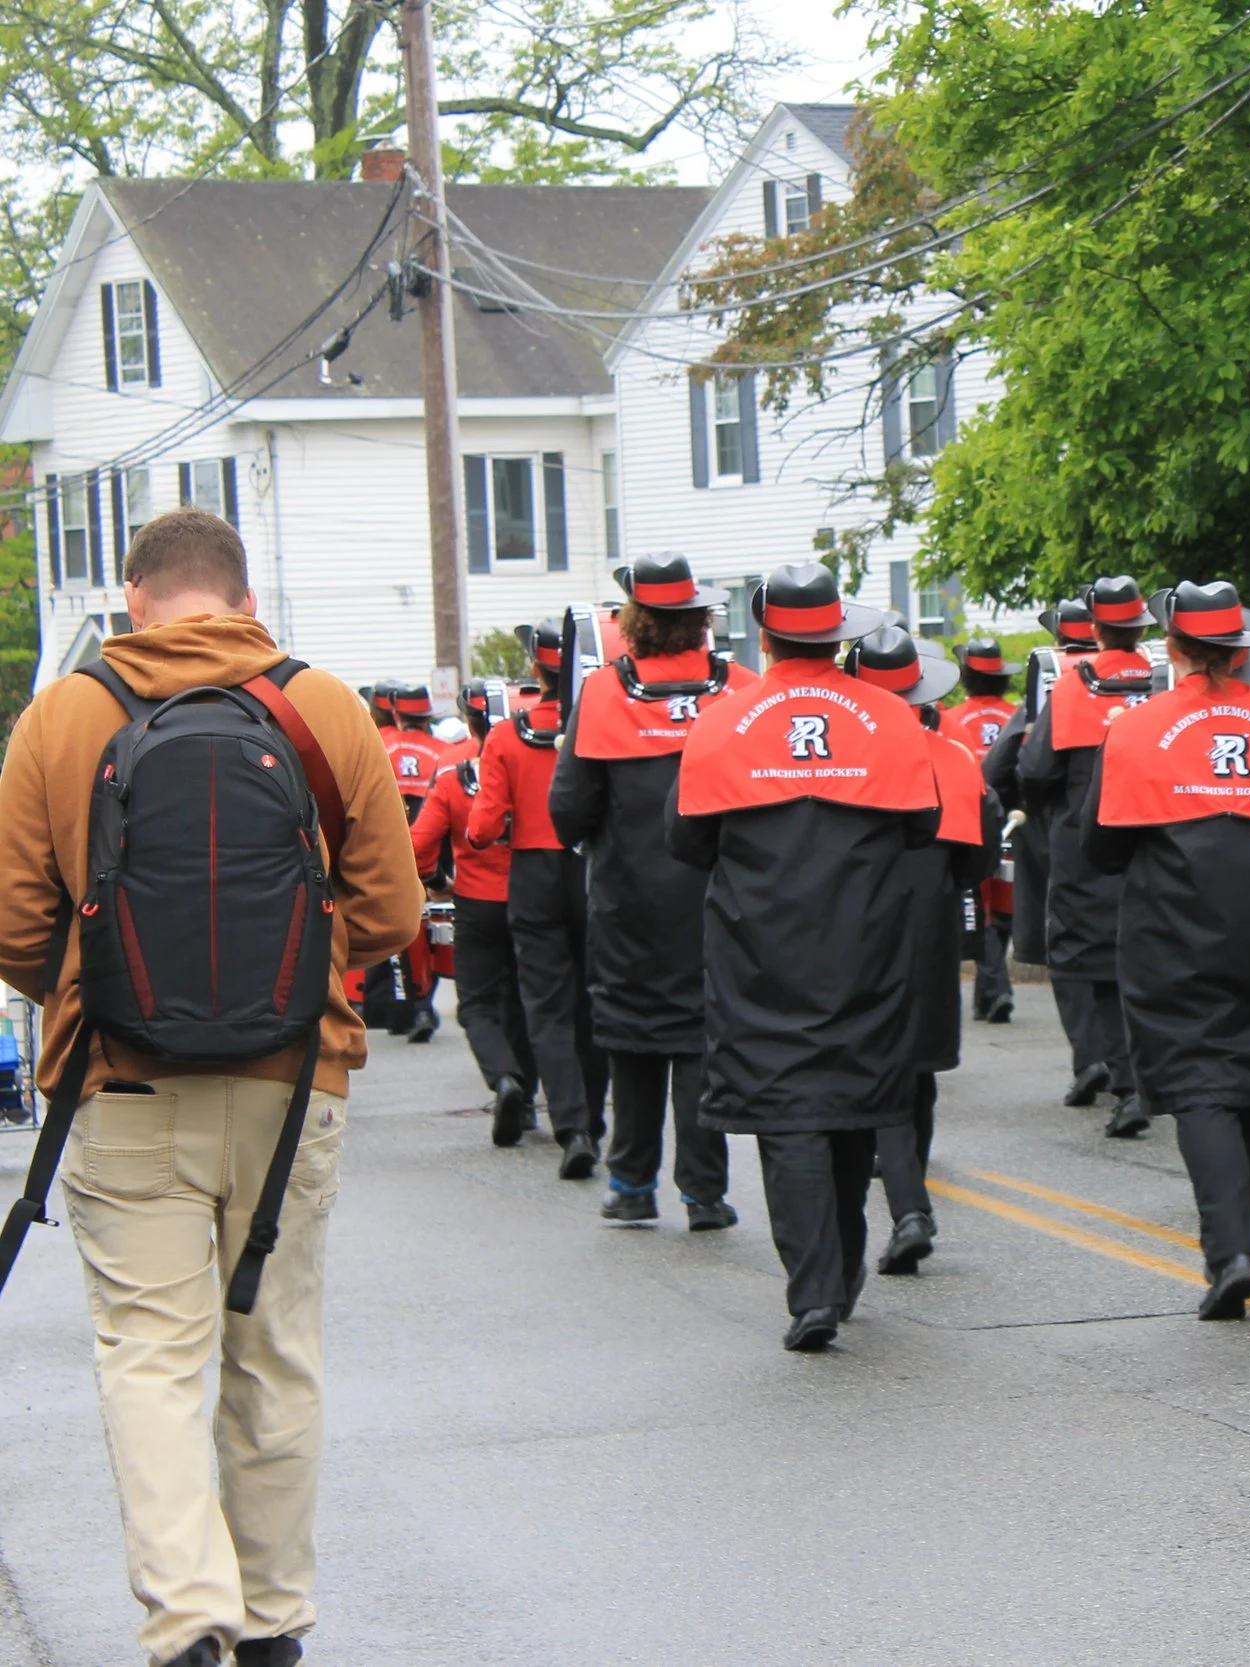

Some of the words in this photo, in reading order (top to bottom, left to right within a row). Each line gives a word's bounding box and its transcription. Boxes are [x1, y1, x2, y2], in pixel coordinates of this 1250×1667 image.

[736, 692, 786, 735] READING
[788, 687, 858, 713] MEMORIAL
[1159, 709, 1208, 750] READING
[784, 714, 832, 761] R
[751, 768, 812, 778] MARCHING
[815, 768, 867, 777] ROCKETS
[1173, 785, 1233, 796] MARCHING
